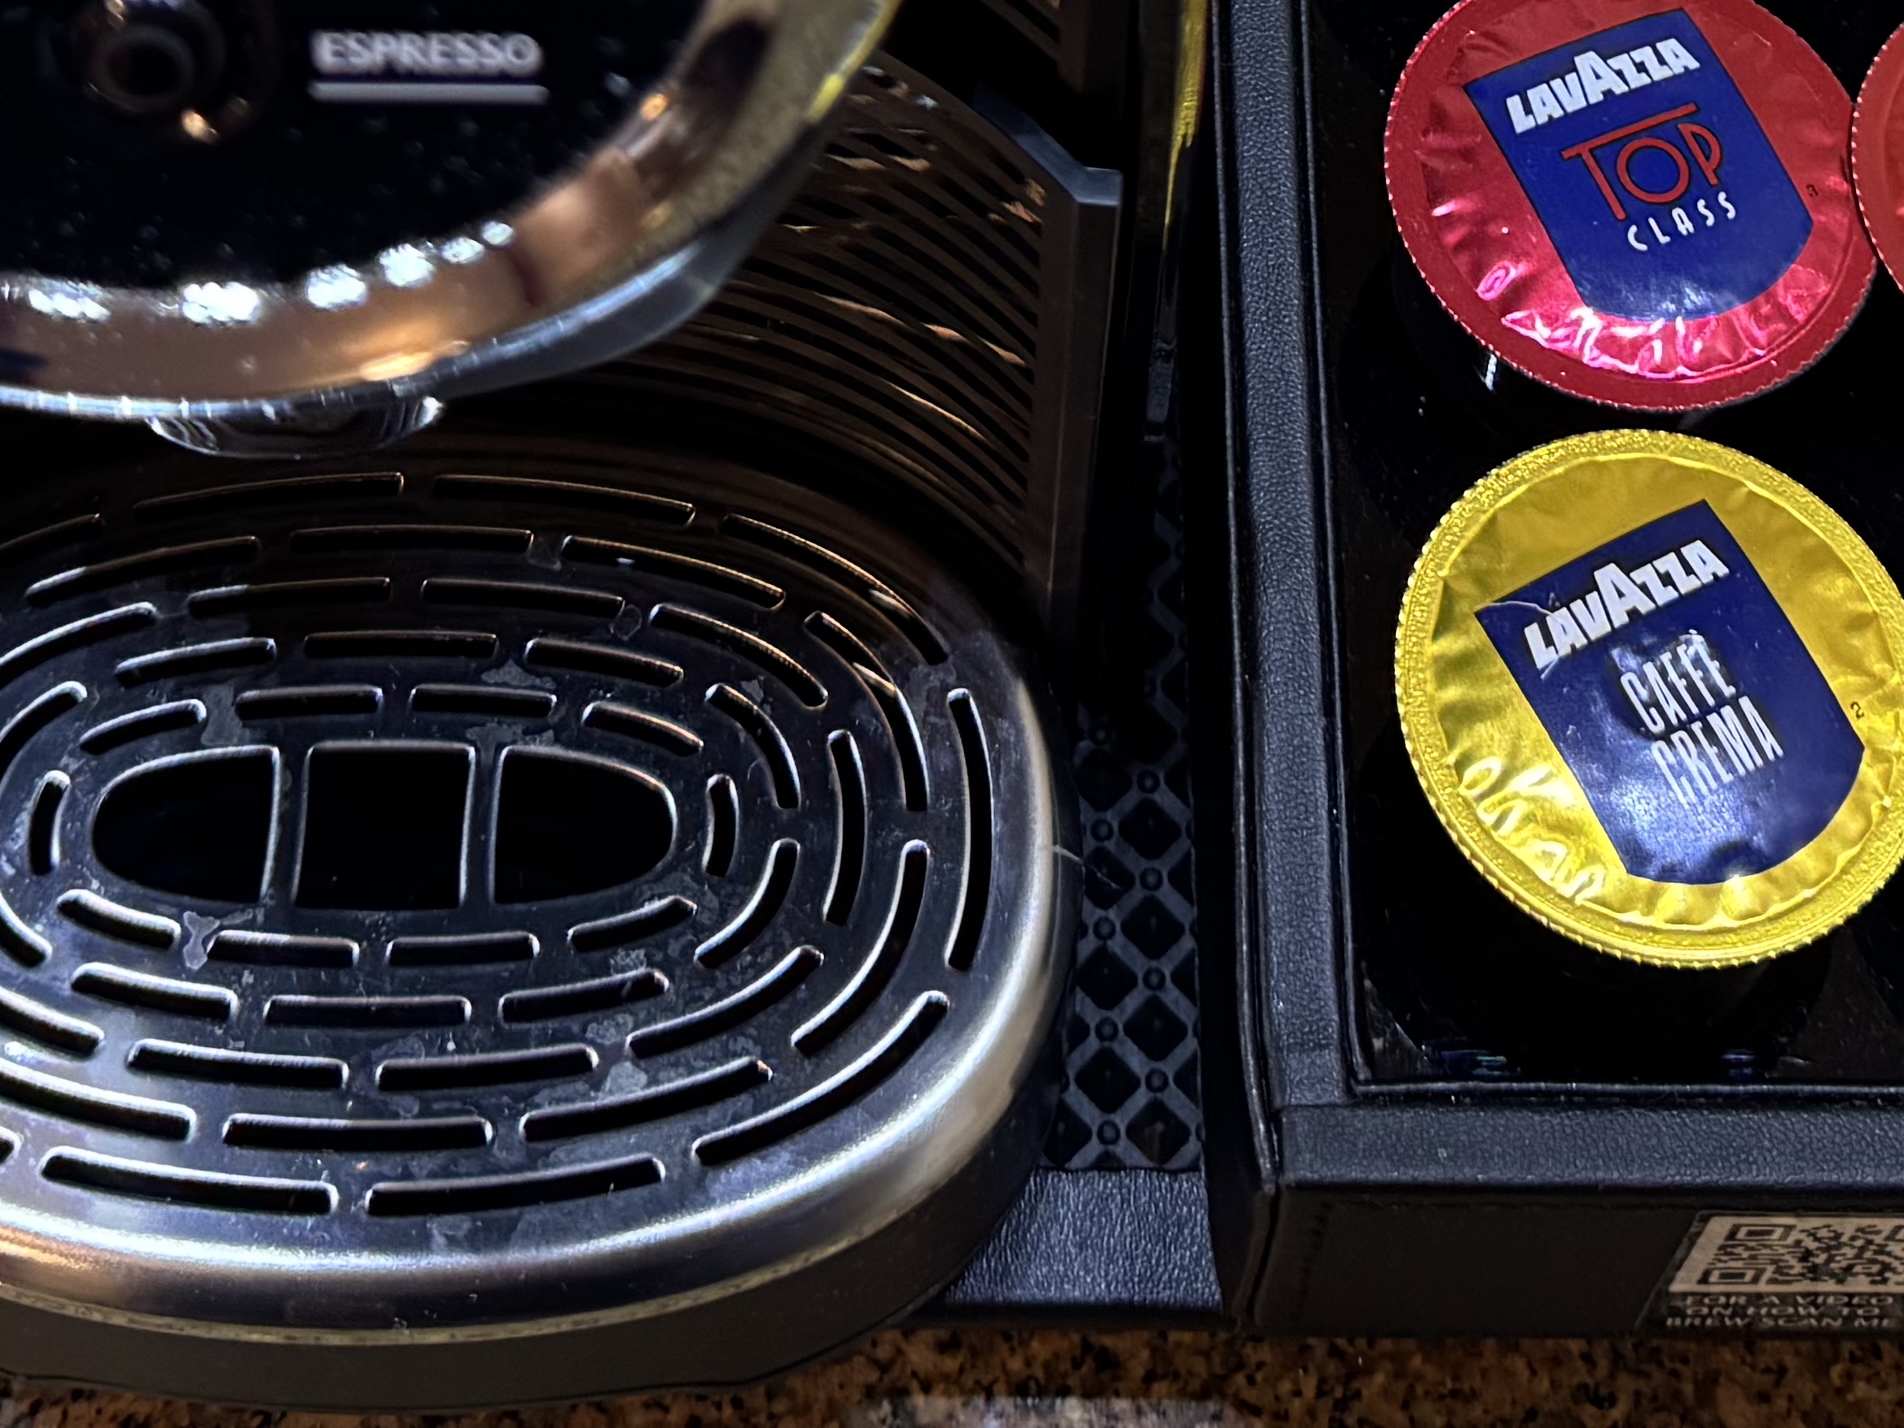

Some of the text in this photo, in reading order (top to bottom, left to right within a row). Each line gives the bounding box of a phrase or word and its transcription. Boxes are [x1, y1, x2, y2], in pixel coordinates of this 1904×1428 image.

[312, 31, 542, 75] ESPRESSO
[1561, 103, 1723, 220] TOP
[1627, 191, 1737, 251] CLASS
[1621, 629, 1736, 733] CAFFÈ
[1850, 700, 1866, 720] 2
[1651, 695, 1784, 805] CREMA
[1666, 1316, 1892, 1327] BREW SCAN ME
[1686, 1295, 1894, 1305] FOR A VIDEO
[1686, 1306, 1880, 1316] ON HOW TO
